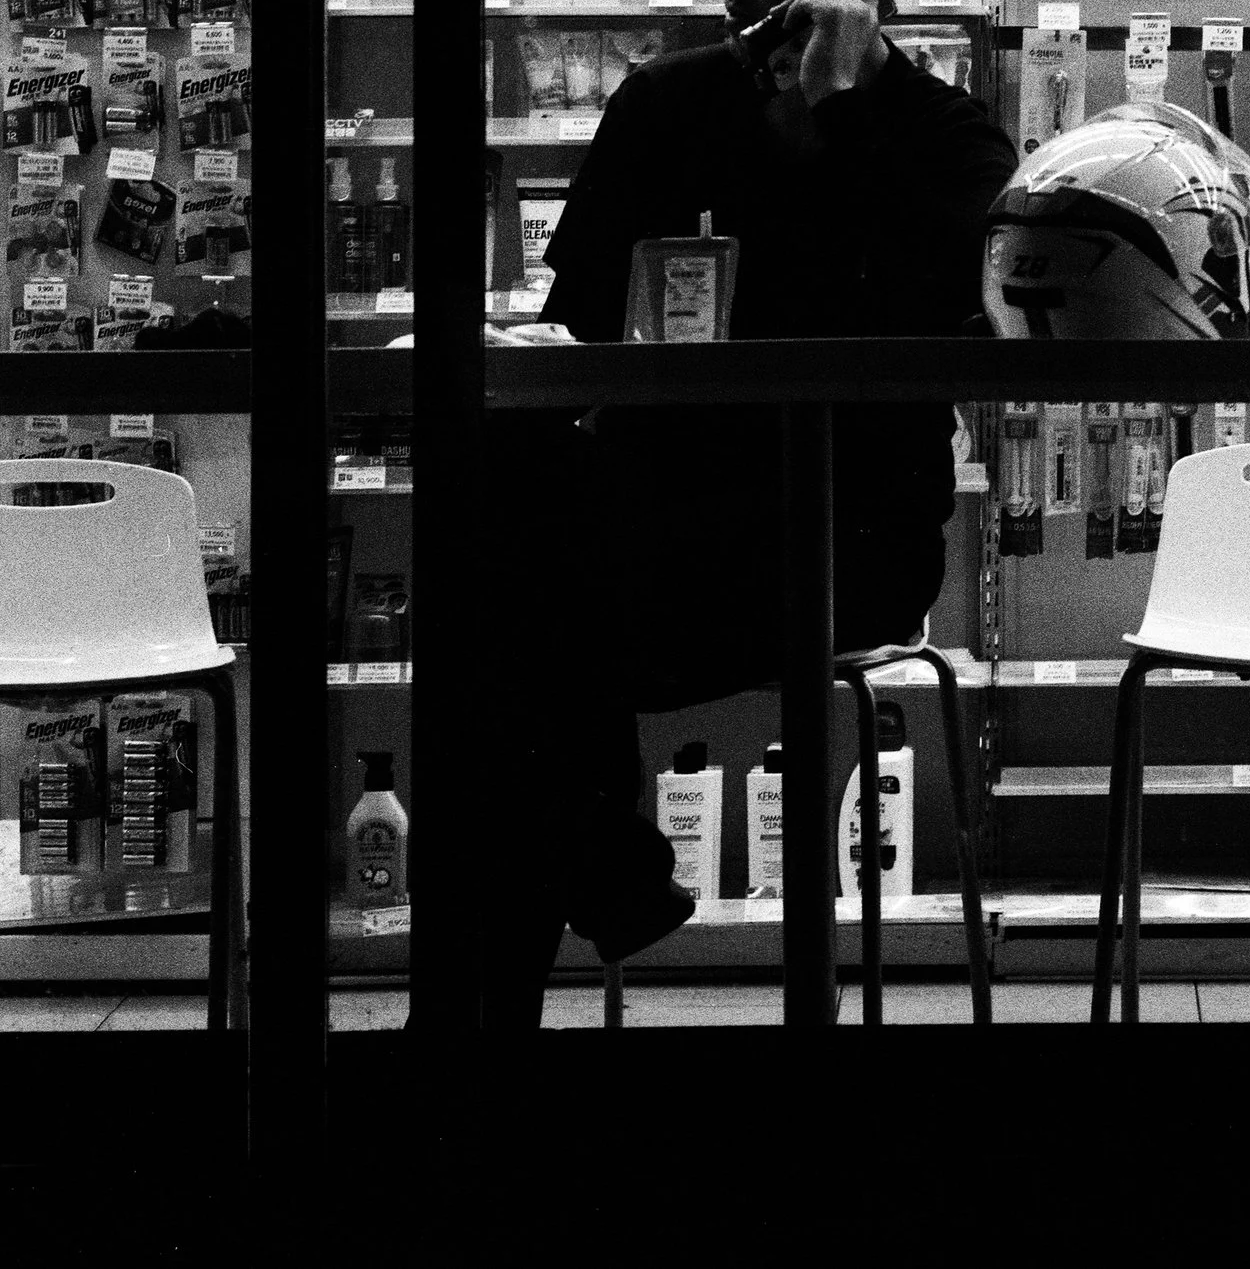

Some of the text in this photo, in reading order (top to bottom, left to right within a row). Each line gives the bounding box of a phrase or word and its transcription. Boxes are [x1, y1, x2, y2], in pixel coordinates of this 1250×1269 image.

[50, 28, 66, 39] 2+1
[6, 69, 85, 99] Energizer
[108, 69, 152, 85] Energizer
[180, 66, 249, 100] Energize
[326, 119, 363, 129] CCTV
[11, 199, 55, 218] Energizer
[123, 196, 158, 215] Boxel
[181, 194, 234, 215] Energizer
[524, 220, 548, 230] DEEP
[523, 230, 554, 240] CLEAN
[13, 322, 62, 341] Energizer
[97, 321, 145, 339] Energizer
[381, 445, 412, 456] DASHU
[204, 563, 239, 587] rgizer
[26, 713, 94, 739] Energizer
[117, 707, 181, 734] Energizer
[667, 791, 704, 803] KERASYS
[757, 791, 782, 802] KERAS
[669, 815, 701, 824] DAMAGE
[673, 822, 698, 831] CLINIC
[760, 815, 782, 824] DAMA
[764, 822, 782, 830] CLIN
